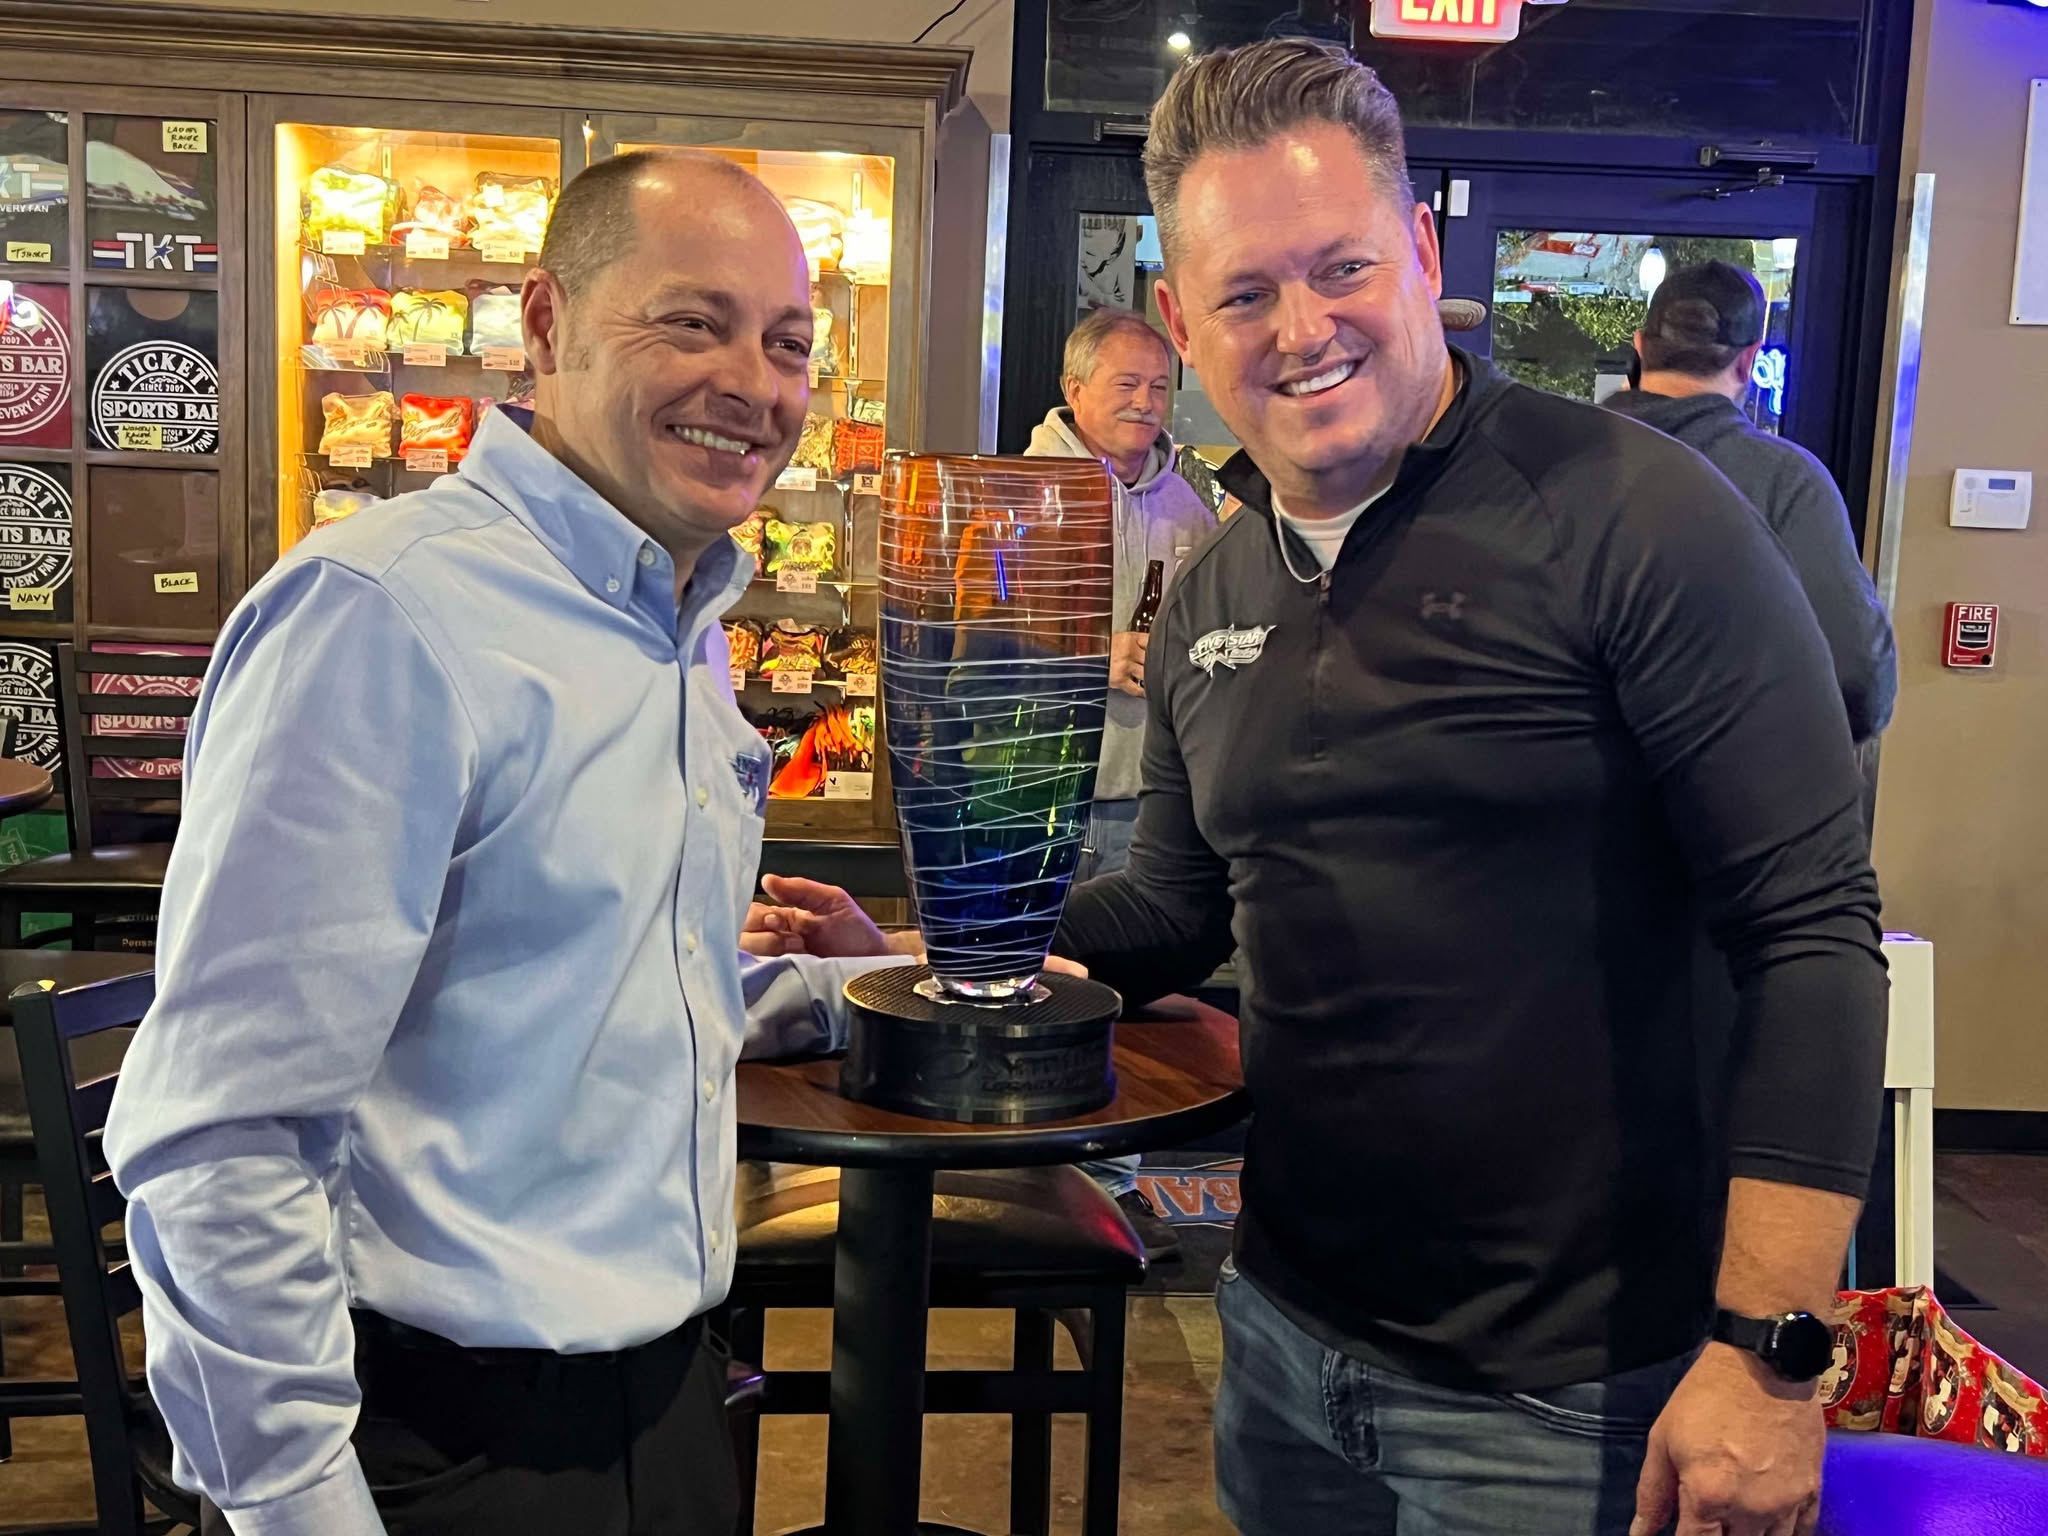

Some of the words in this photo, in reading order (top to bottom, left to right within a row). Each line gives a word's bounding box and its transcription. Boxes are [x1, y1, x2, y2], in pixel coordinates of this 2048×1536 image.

[28, 204, 49, 213] FAN
[116, 232, 202, 271] TKT
[21, 356, 62, 374] BAR
[118, 352, 209, 386] TICKET
[31, 383, 52, 406] FAN
[102, 400, 179, 419] SPORTS
[195, 430, 216, 452] FAN
[29, 527, 71, 546] BAR
[3, 570, 39, 589] EVERY
[37, 555, 59, 577] FAN
[160, 578, 194, 588] BLACK
[17, 593, 51, 605] NAVY
[1958, 606, 1993, 620] FIRE
[1228, 632, 1265, 646] STAR
[38, 735, 60, 756] FAN
